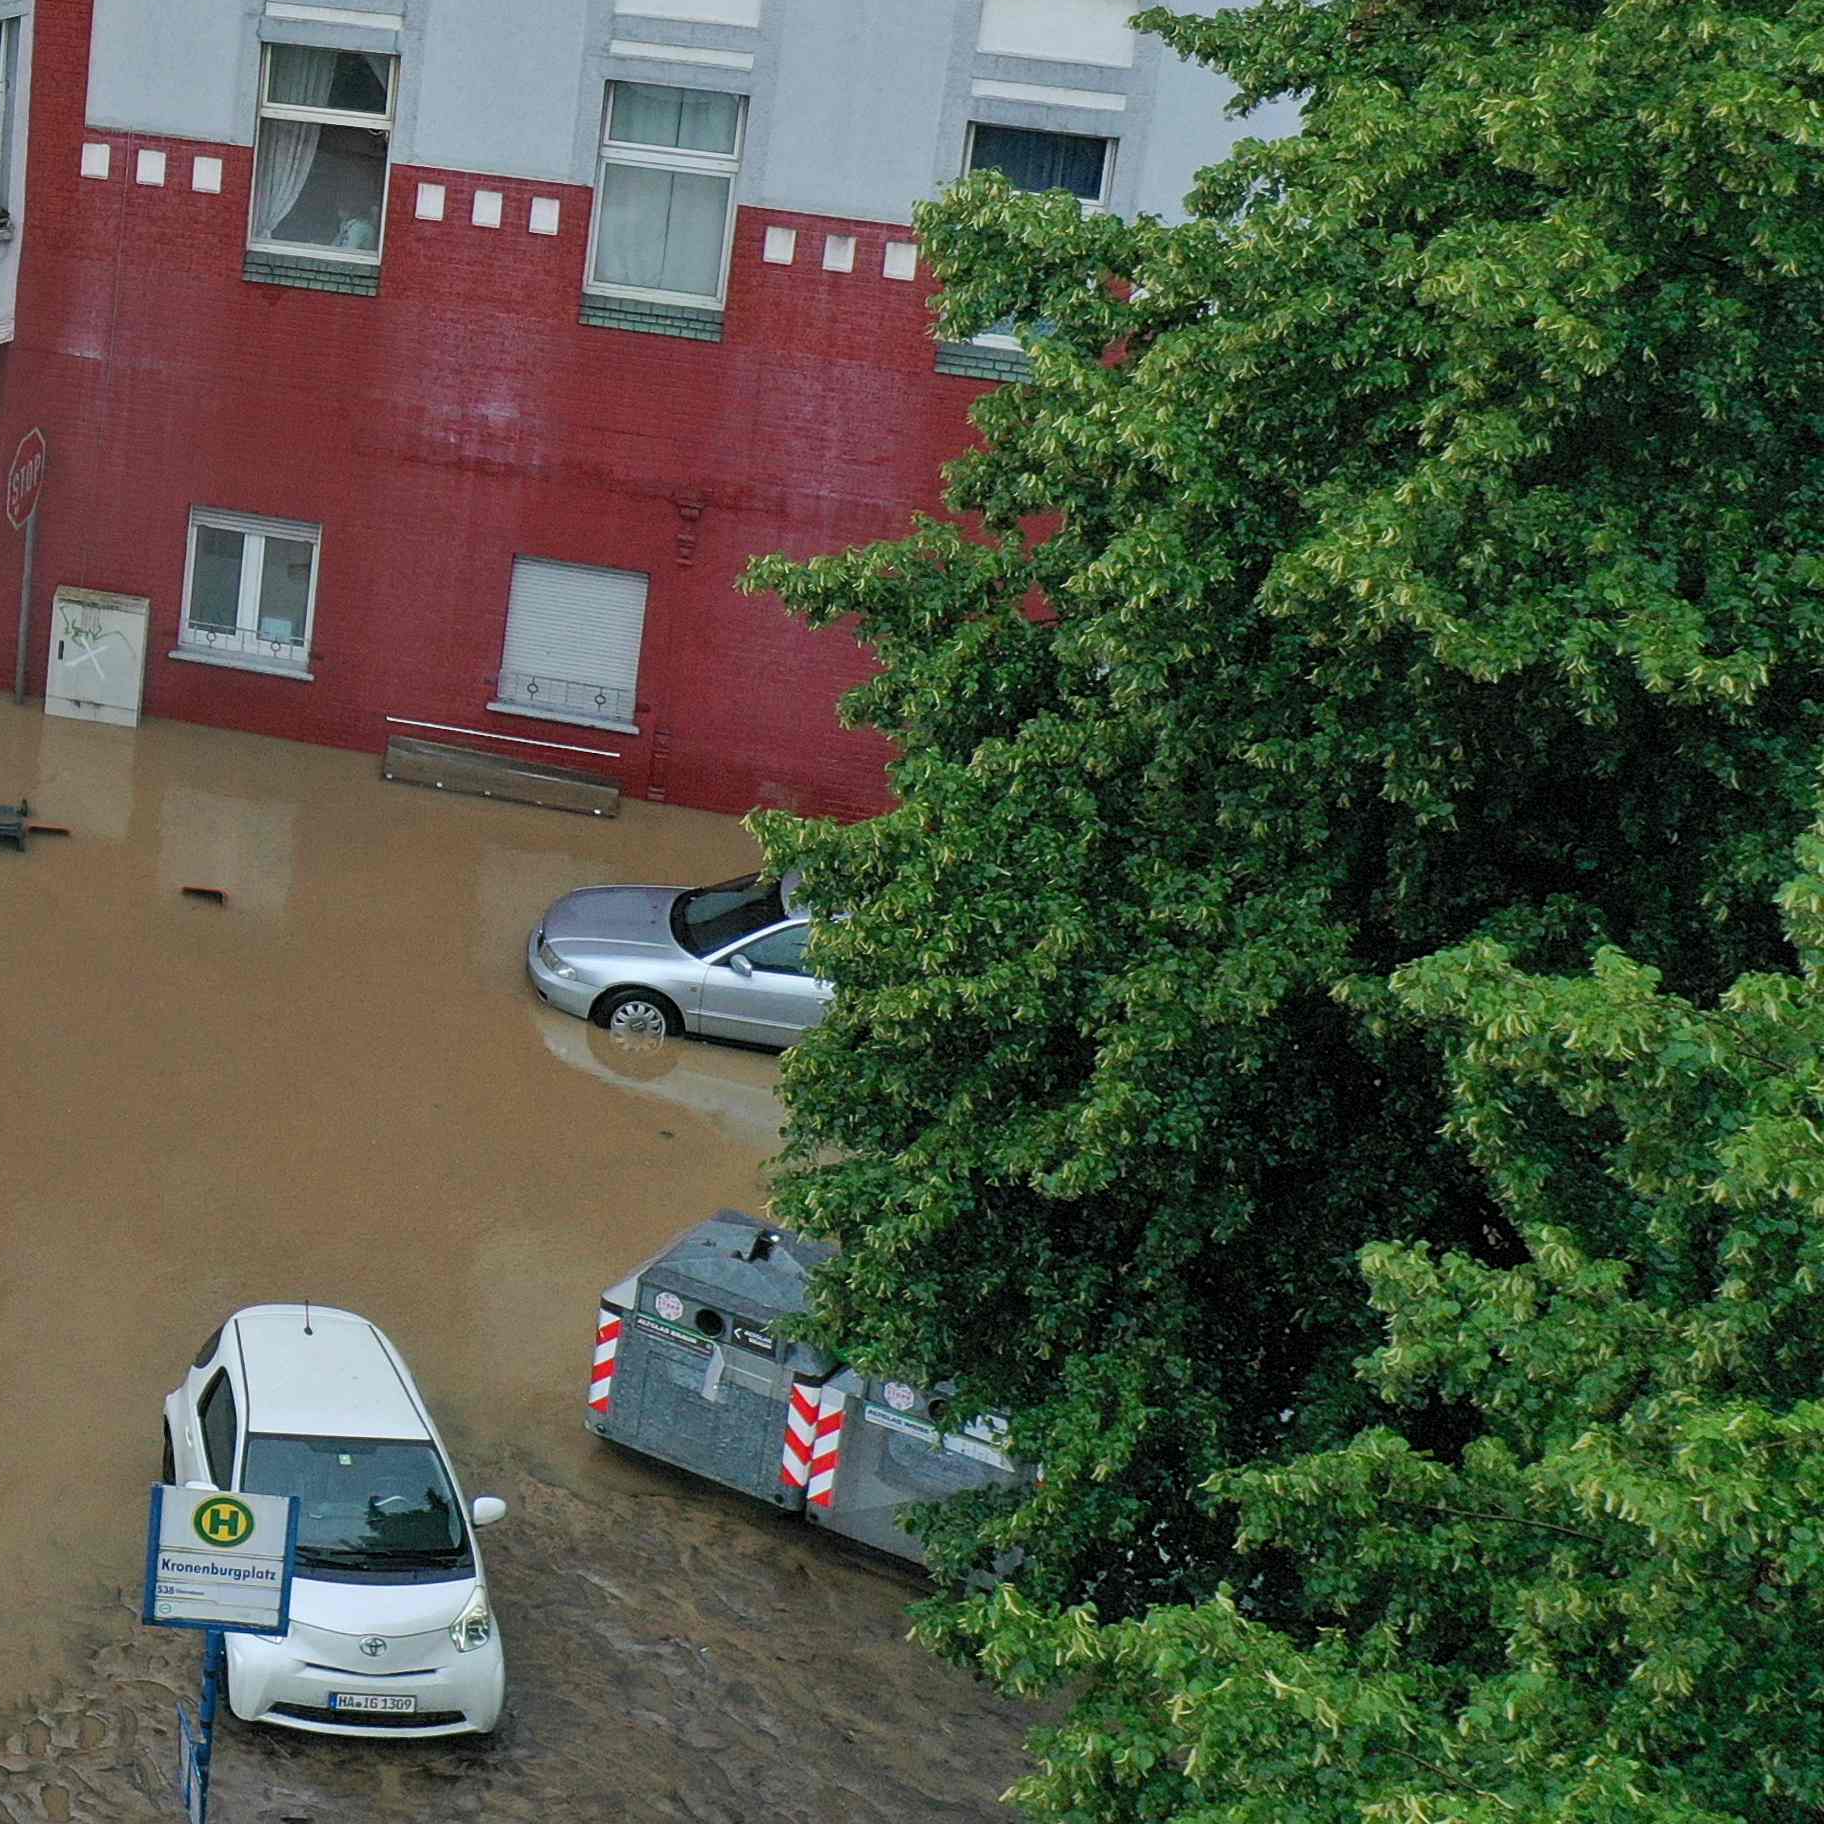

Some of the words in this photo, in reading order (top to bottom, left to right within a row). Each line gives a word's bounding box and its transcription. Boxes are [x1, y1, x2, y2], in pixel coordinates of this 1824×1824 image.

[12, 452, 42, 498] STOP
[160, 1557, 277, 1582] Kronenburgplatz
[337, 1694, 354, 1708] HA
[382, 1697, 413, 1711] 1309
